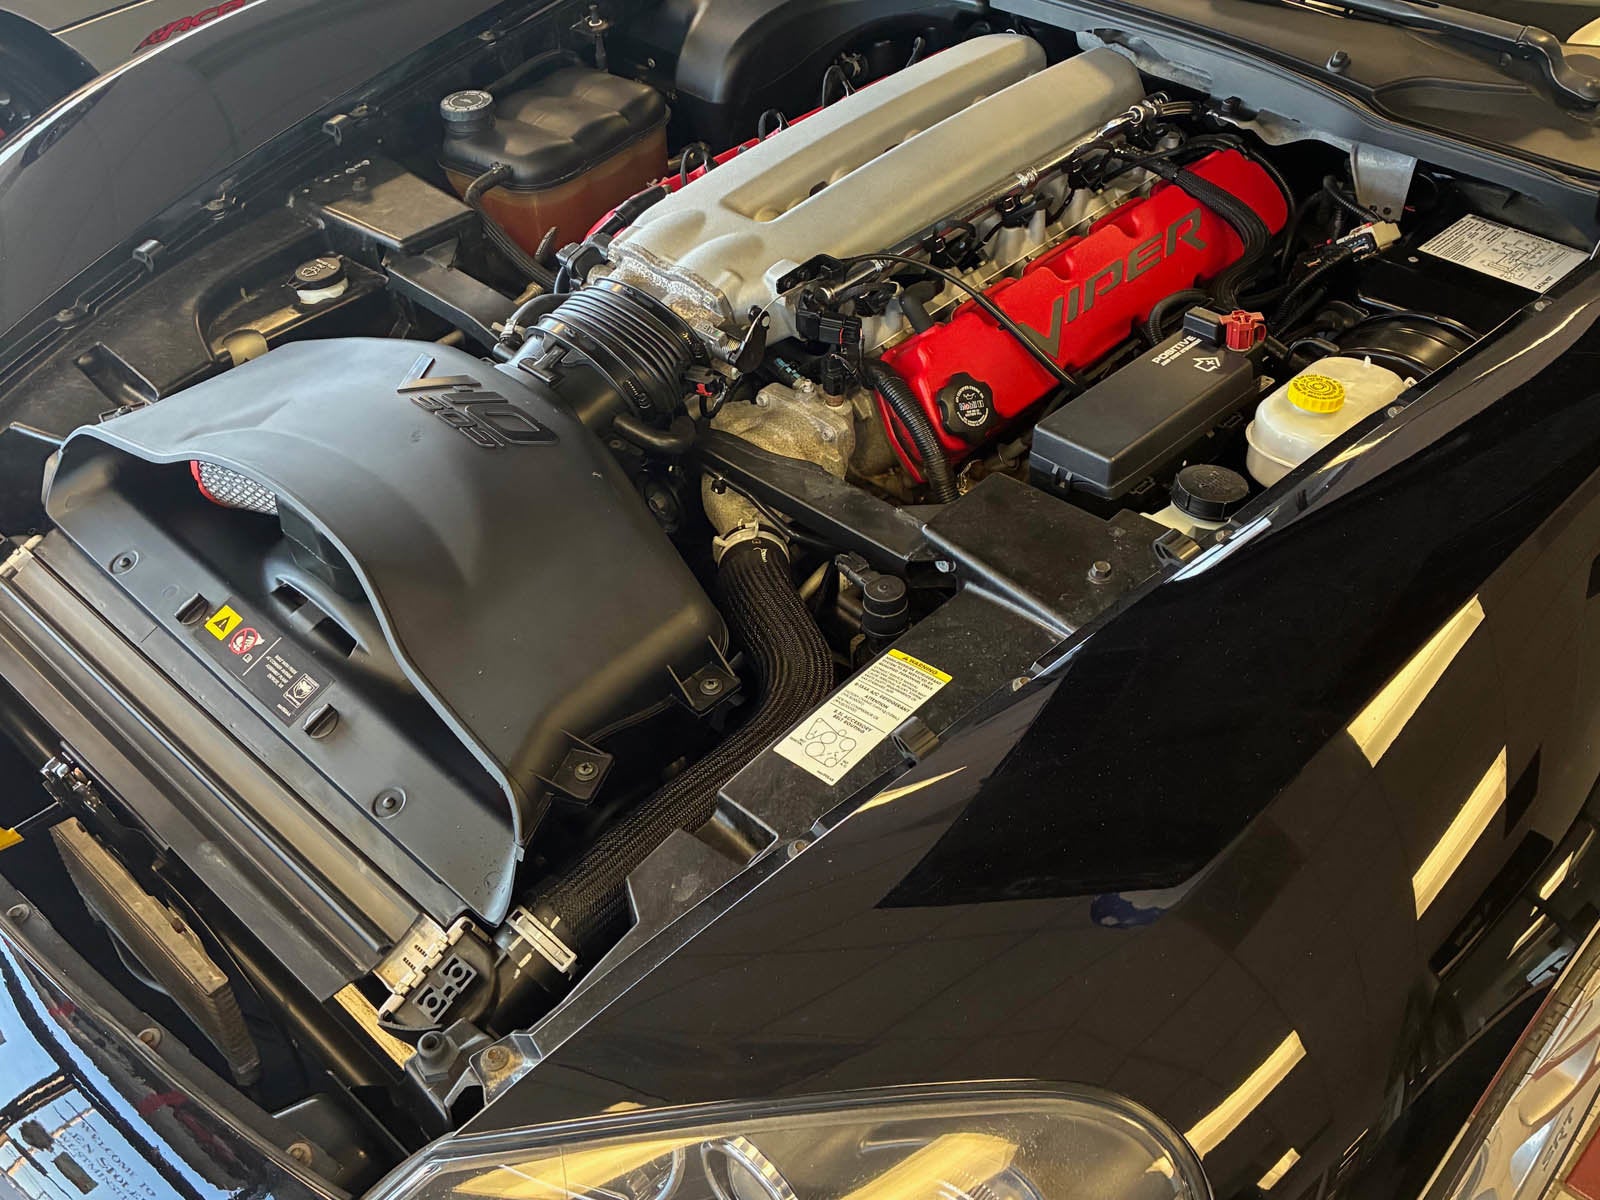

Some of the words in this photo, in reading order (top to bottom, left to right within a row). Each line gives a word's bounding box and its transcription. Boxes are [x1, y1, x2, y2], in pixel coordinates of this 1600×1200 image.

[1017, 207, 1208, 359] VIPER
[1152, 335, 1197, 364] POSITIVE
[396, 353, 561, 445] V10
[909, 659, 937, 674] WARNING
[864, 694, 889, 709] ATTENTION
[879, 695, 910, 712] REFRIGERANT
[843, 715, 872, 732] ACCESSORY
[843, 720, 865, 733] ROUTING
[1542, 1107, 1575, 1172] SRT
[79, 1120, 137, 1176] WELCOME
[139, 1181, 157, 1197] TO
[96, 1154, 145, 1200] STOLE
